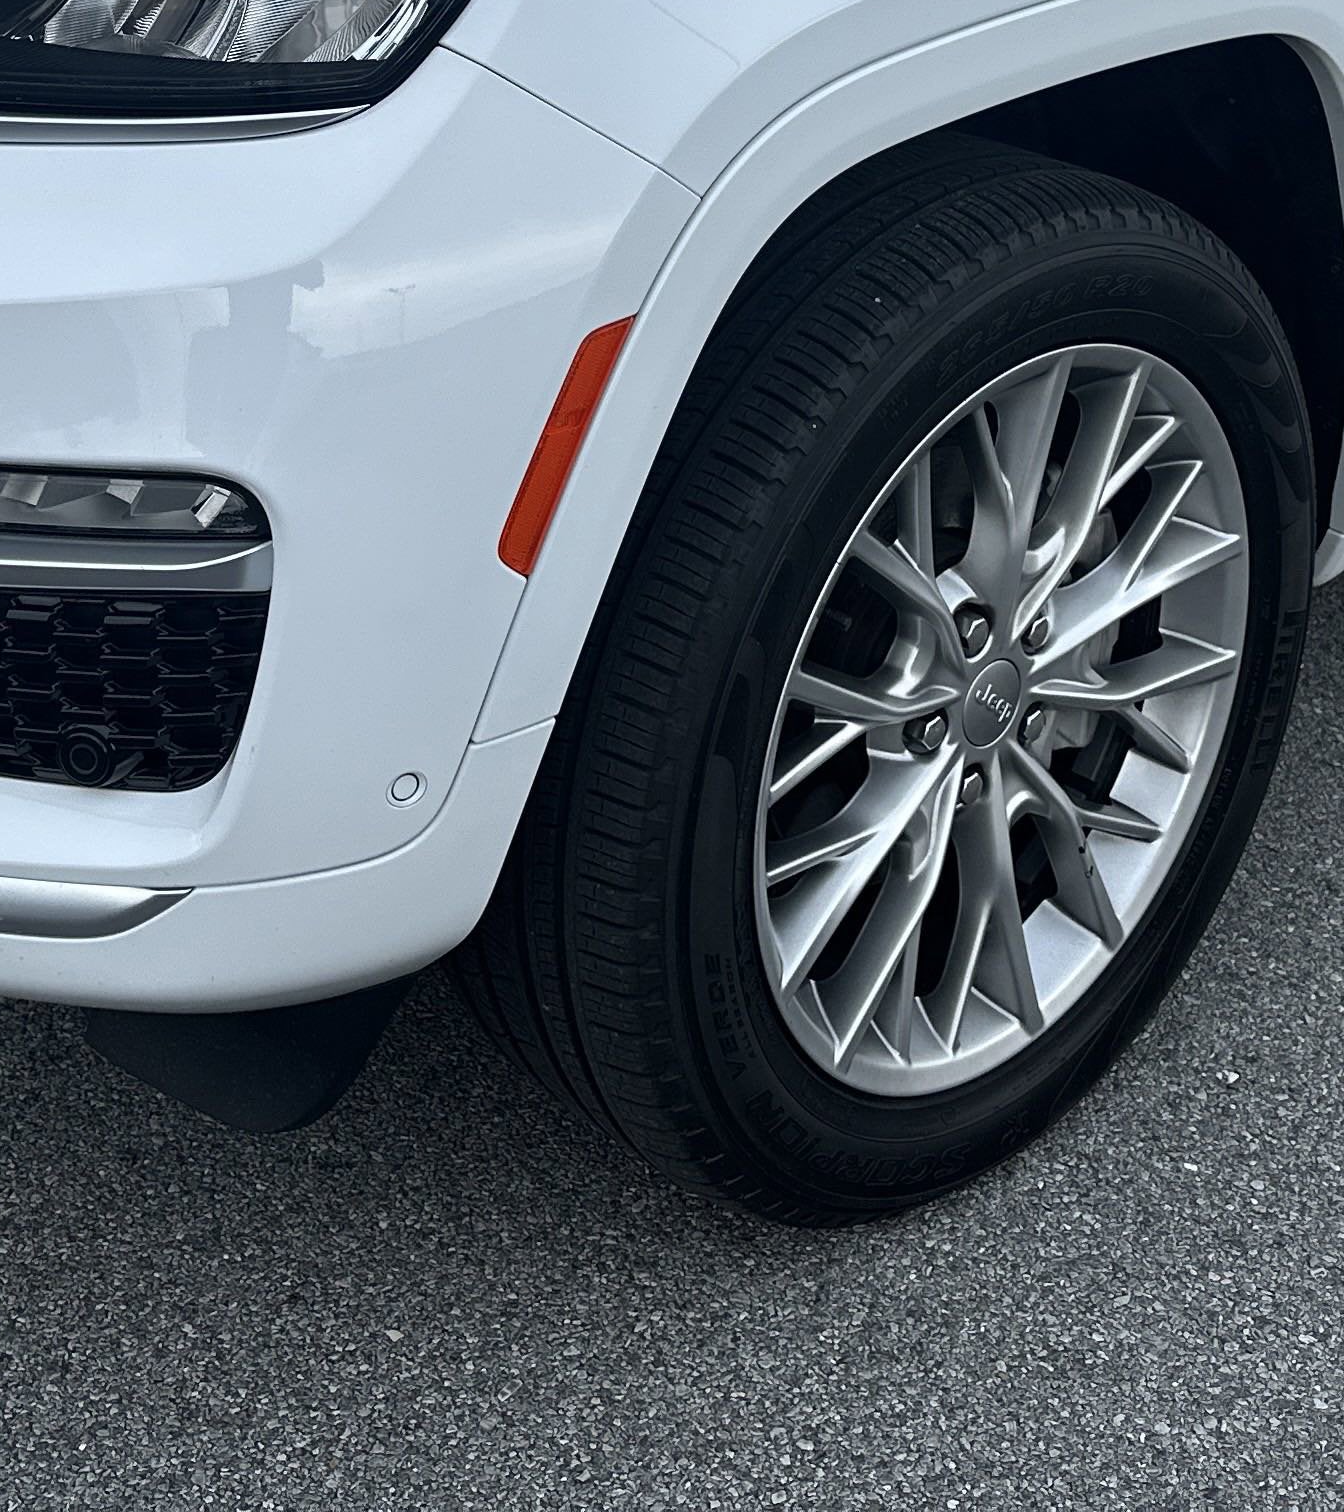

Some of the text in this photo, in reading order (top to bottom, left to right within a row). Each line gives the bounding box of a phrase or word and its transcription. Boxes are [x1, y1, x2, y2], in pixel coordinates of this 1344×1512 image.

[976, 683, 1013, 723] Jeep
[703, 952, 972, 1187] SCORPION VERDE
